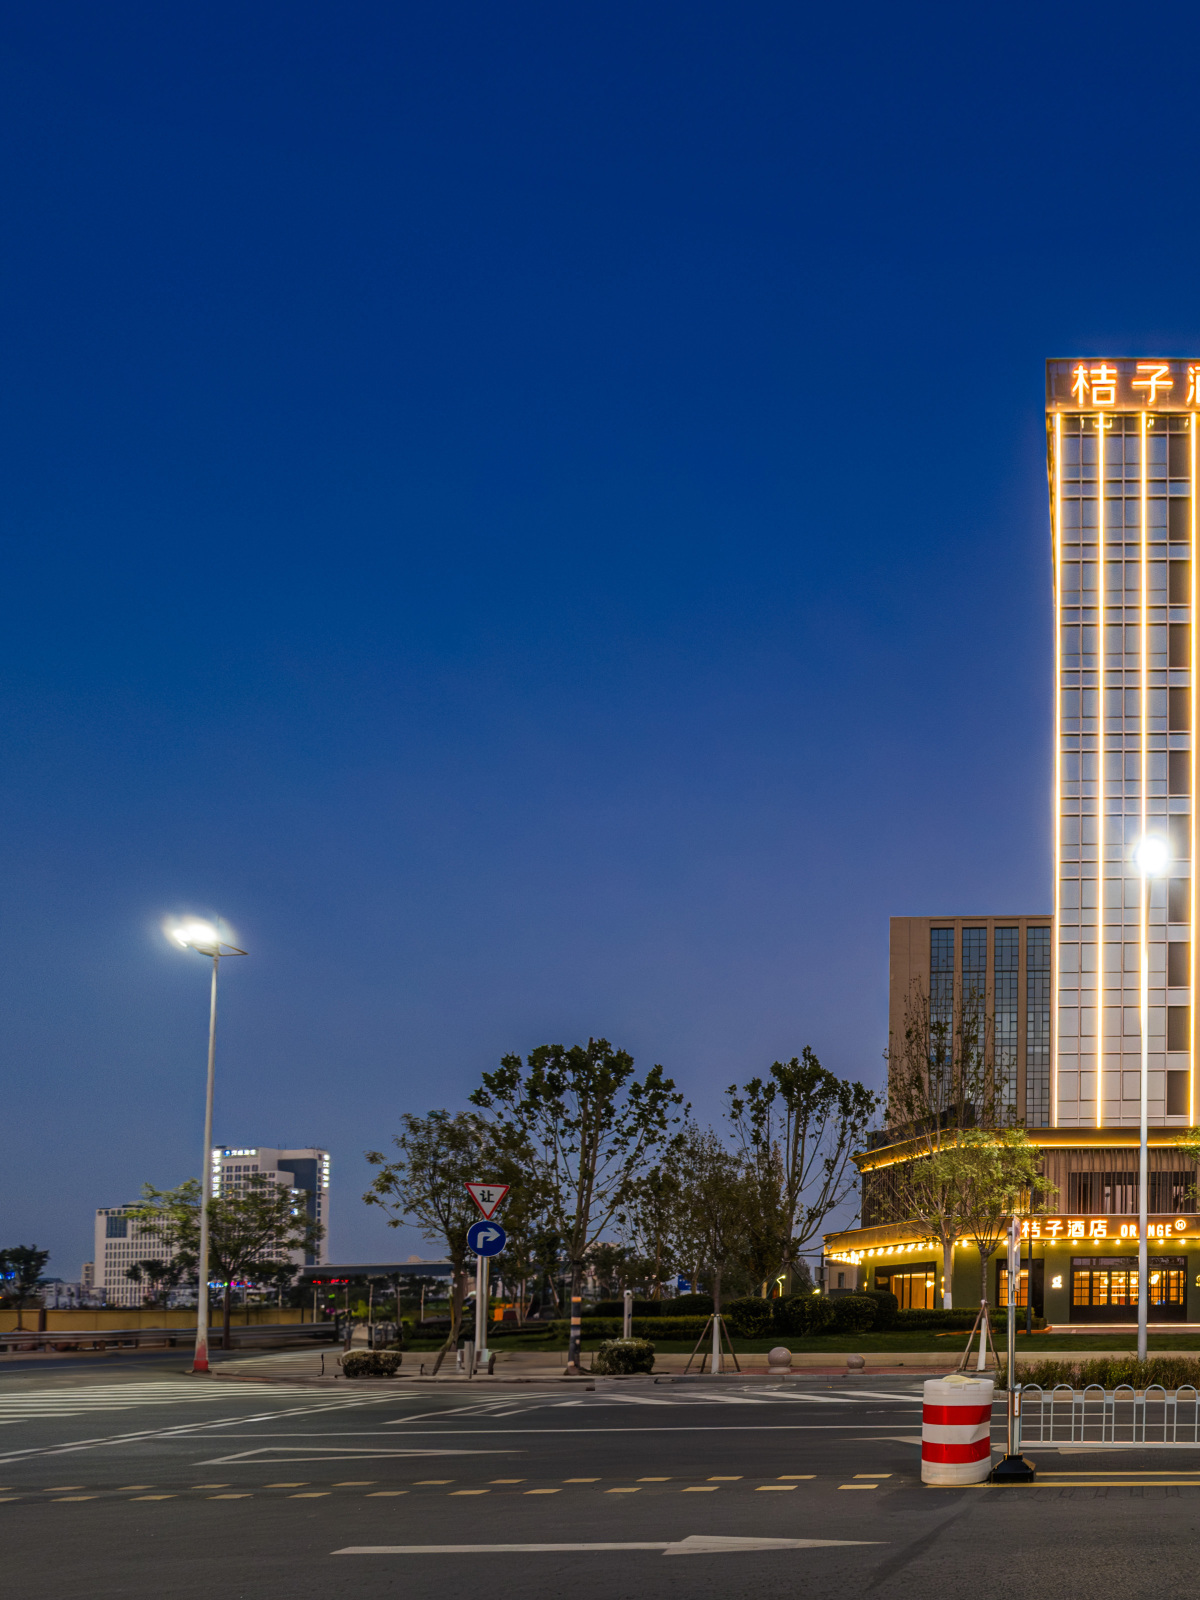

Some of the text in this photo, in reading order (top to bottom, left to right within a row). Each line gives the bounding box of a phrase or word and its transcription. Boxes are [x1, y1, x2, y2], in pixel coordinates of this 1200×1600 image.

[479, 1189, 495, 1203] 让
[1021, 1219, 1108, 1238] 桔子酒店
[1120, 1224, 1172, 1237] ORNGE
